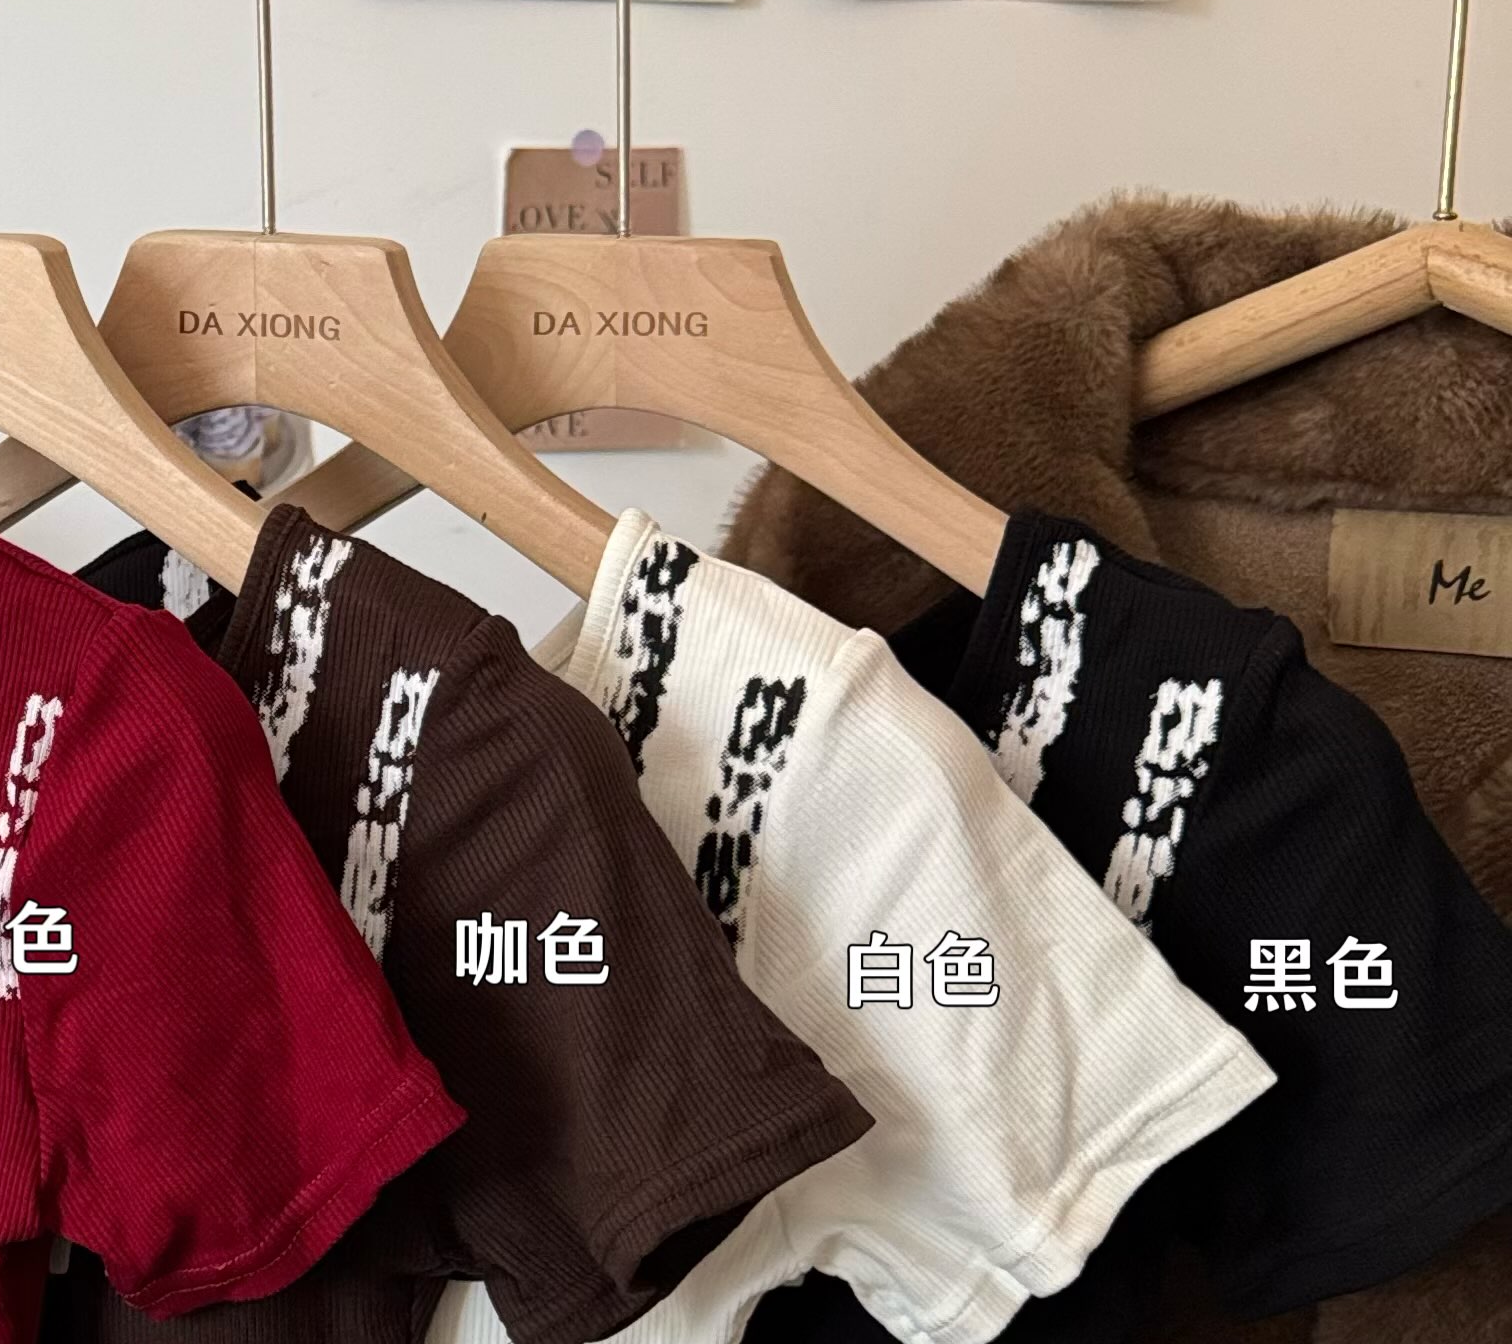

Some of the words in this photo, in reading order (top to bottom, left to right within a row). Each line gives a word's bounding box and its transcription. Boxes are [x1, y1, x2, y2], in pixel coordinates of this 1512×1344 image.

[594, 160, 677, 189] SLF
[178, 310, 225, 337] DA
[236, 311, 342, 341] XIONG
[532, 311, 582, 336] DA
[595, 311, 709, 337] XIONG
[1428, 559, 1492, 606] Me
